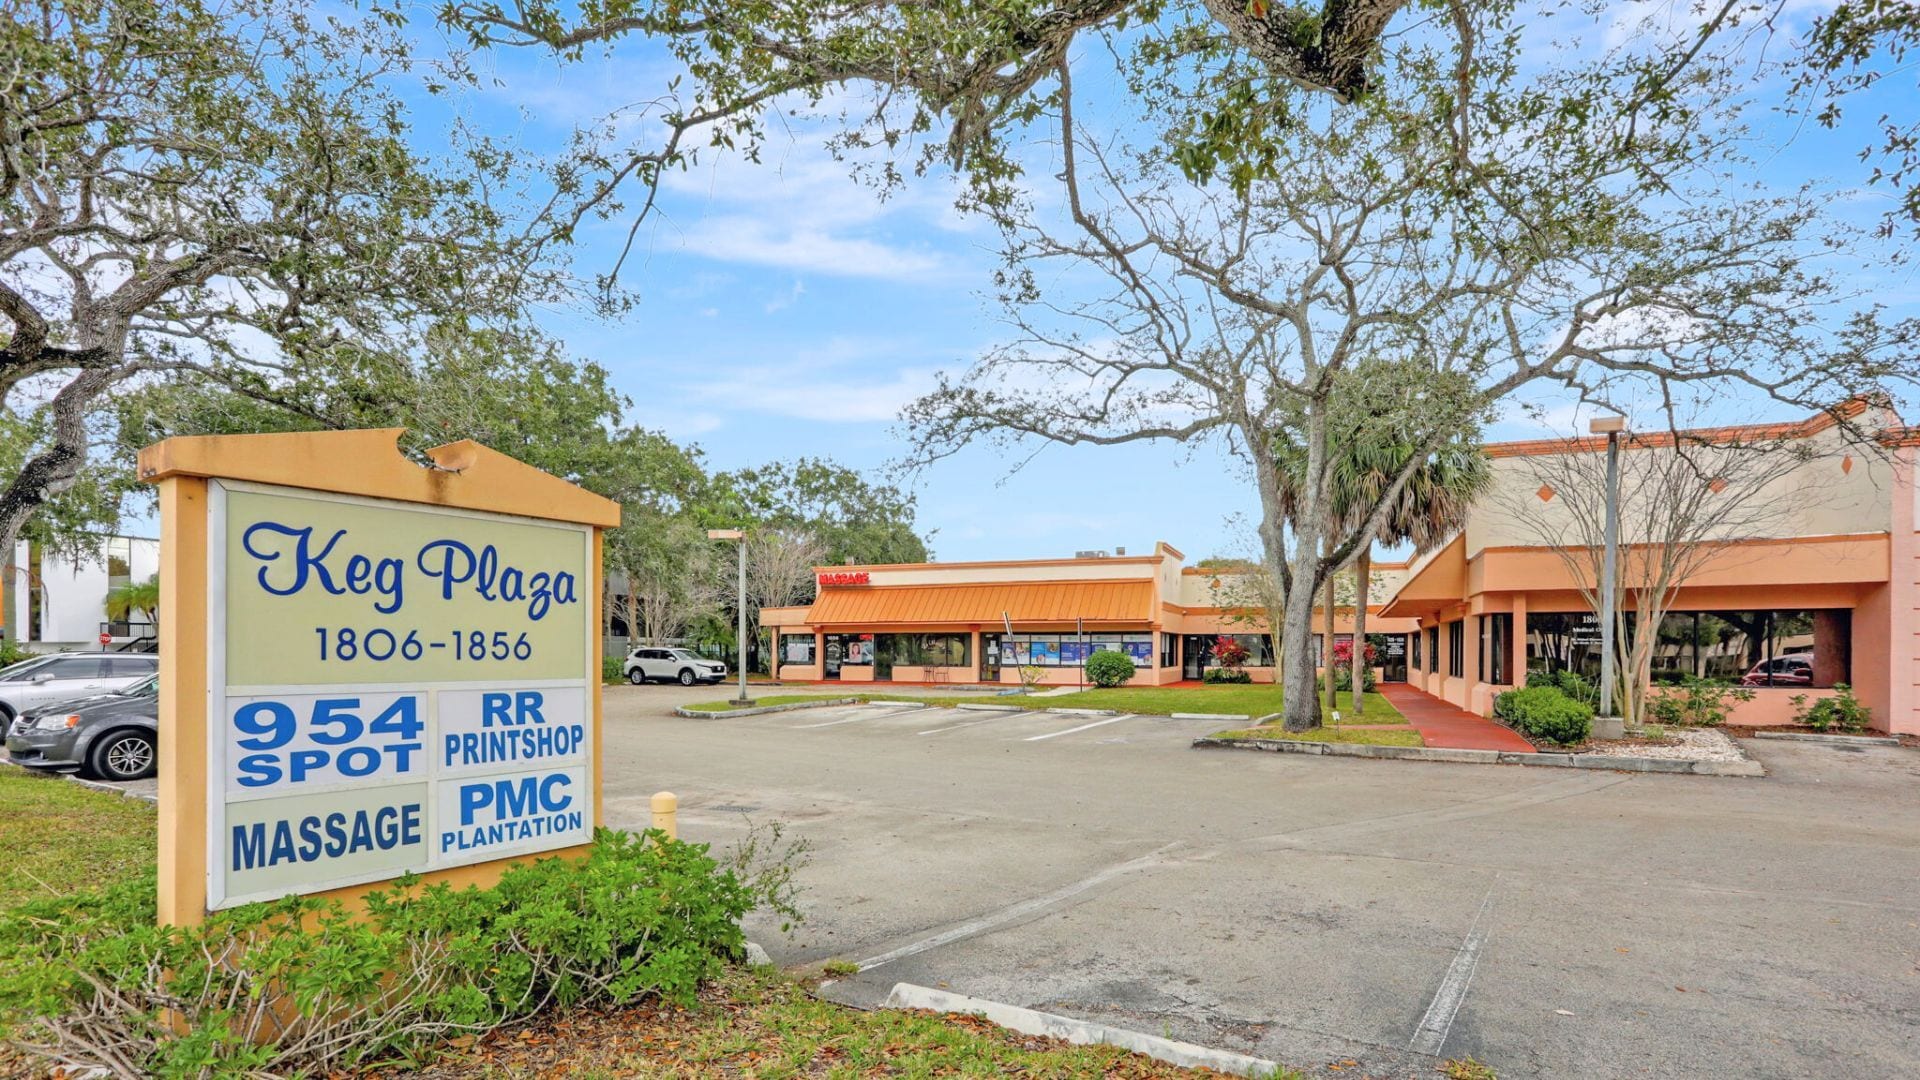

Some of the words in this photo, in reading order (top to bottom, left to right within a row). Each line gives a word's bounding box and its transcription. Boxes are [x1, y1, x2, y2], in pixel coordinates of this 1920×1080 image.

[243, 521, 404, 615] Keg
[417, 540, 578, 622] Plaza
[819, 572, 869, 585] MASSAGE
[316, 627, 534, 662] 1806-1856
[233, 694, 425, 752] 954
[482, 690, 546, 729] RR
[236, 741, 424, 787] SPOT
[445, 723, 583, 768] PRINTSHOP
[460, 772, 573, 826] PMC
[233, 803, 421, 870] MASSAGE
[441, 811, 582, 853] PLANTATION
